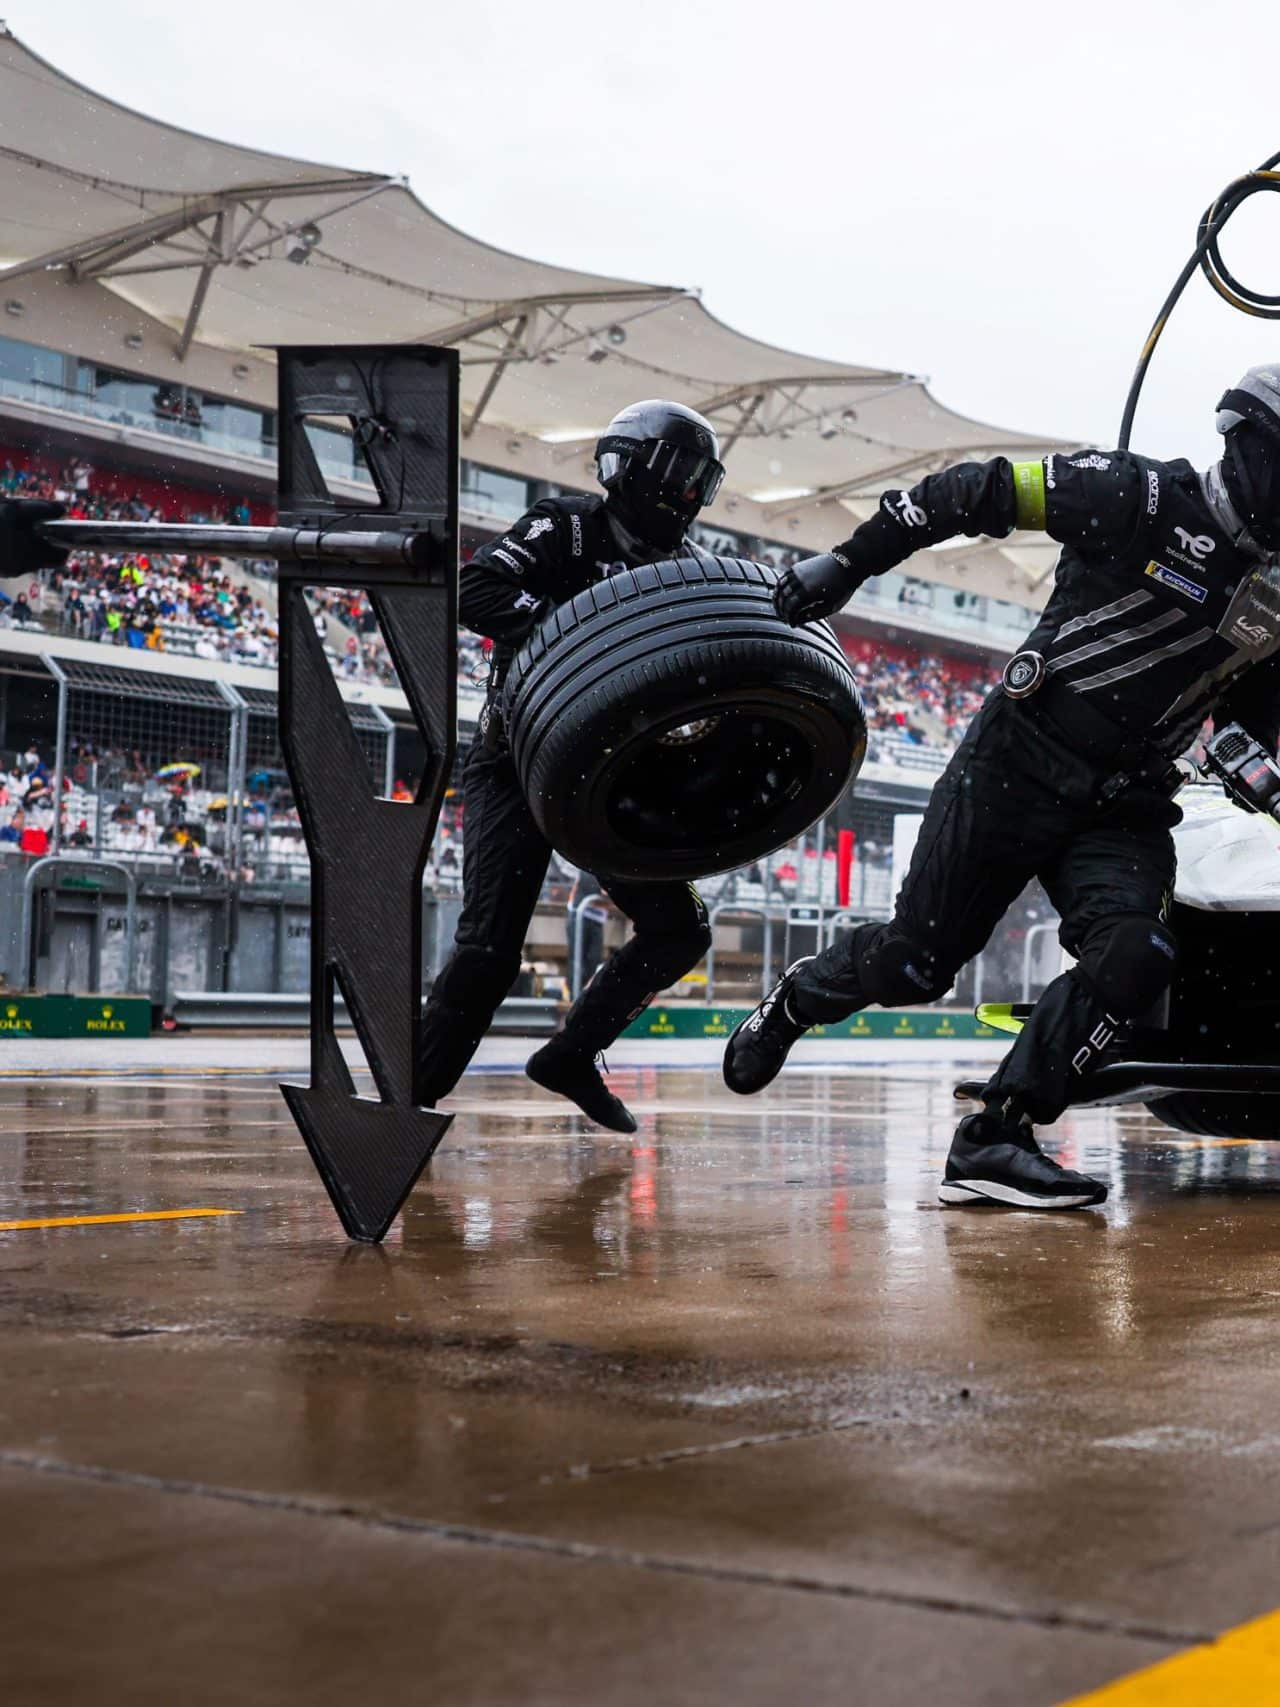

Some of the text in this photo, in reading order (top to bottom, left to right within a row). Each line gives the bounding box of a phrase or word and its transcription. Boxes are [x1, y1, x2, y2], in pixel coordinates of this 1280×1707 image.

[1148, 470, 1161, 515] sparco
[570, 514, 582, 556] sparco
[1163, 574, 1201, 596] MICHELIN
[87, 1020, 125, 1030] ROLEX
